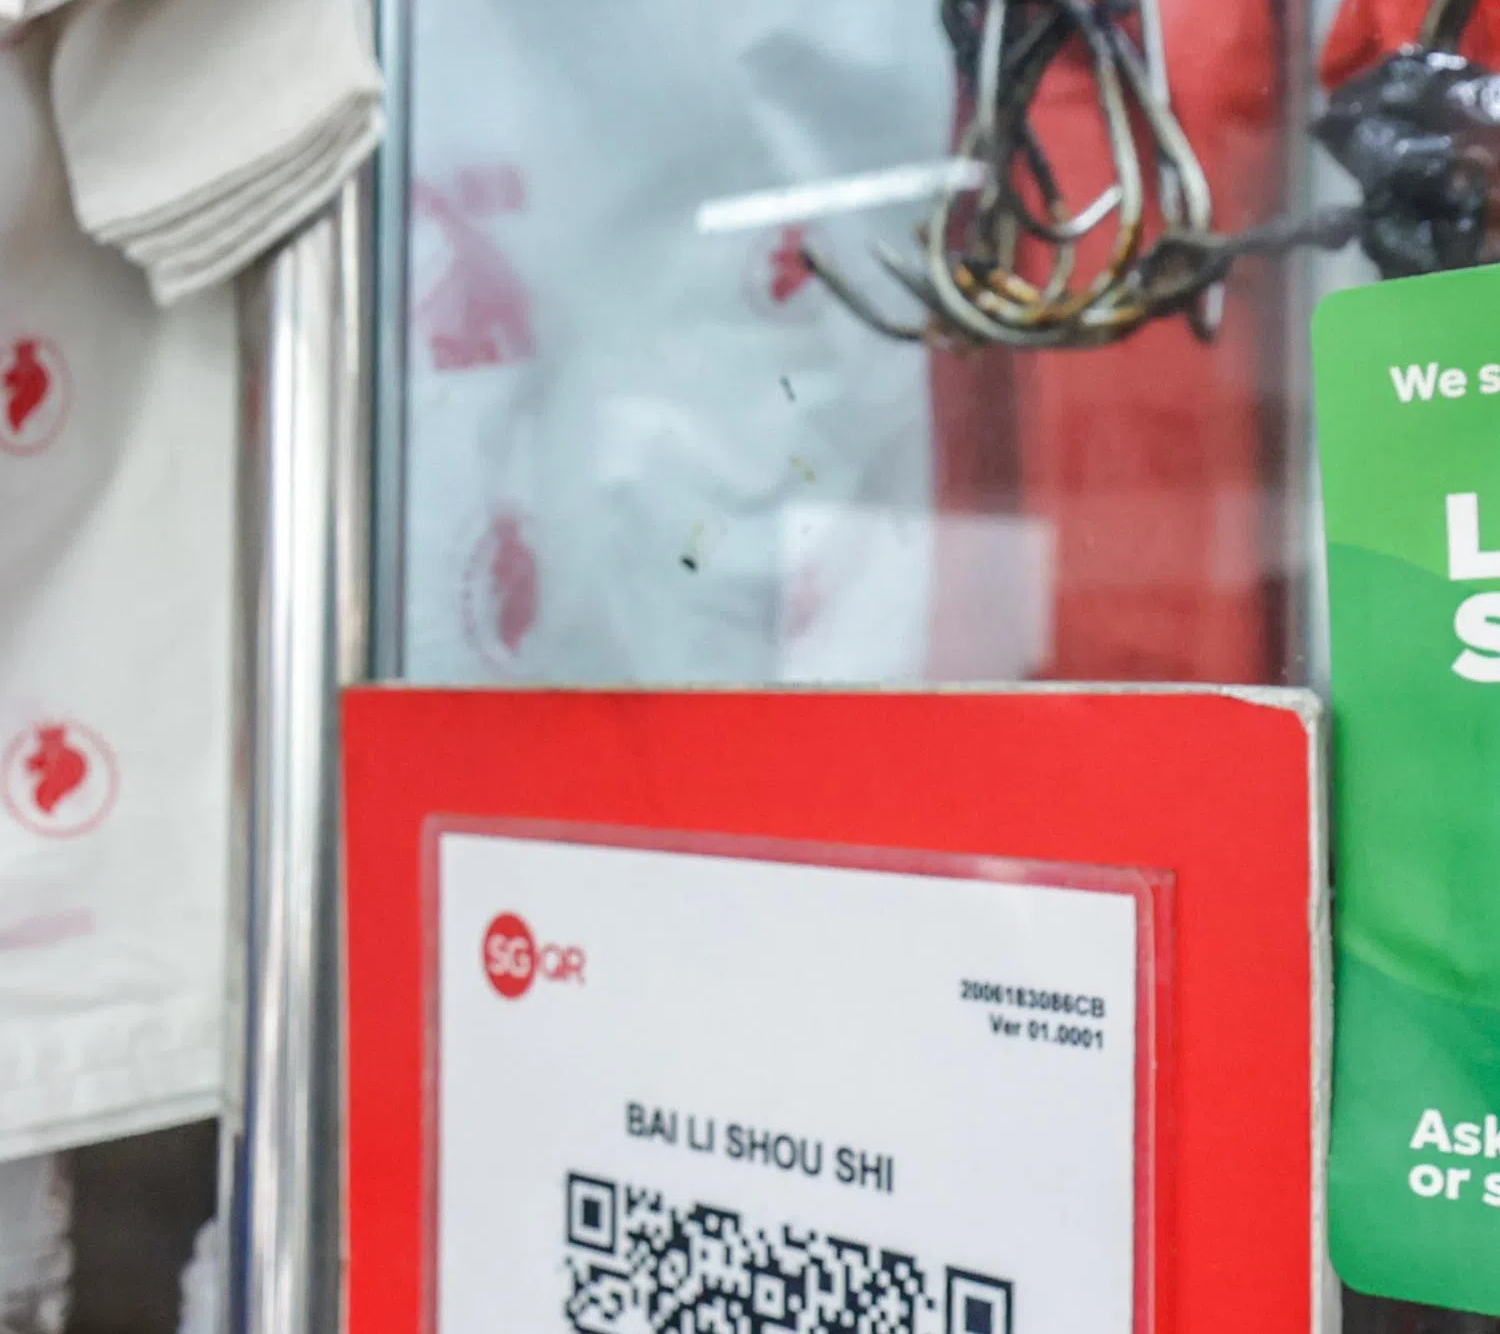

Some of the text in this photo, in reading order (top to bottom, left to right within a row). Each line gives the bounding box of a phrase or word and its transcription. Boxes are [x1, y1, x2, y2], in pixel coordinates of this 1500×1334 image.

[1390, 362, 1467, 402] We
[989, 1013, 1104, 1050] Ver 01.0001
[626, 1101, 894, 1194] BAI LI SHOU SHI
[1408, 1164, 1471, 1200] or
